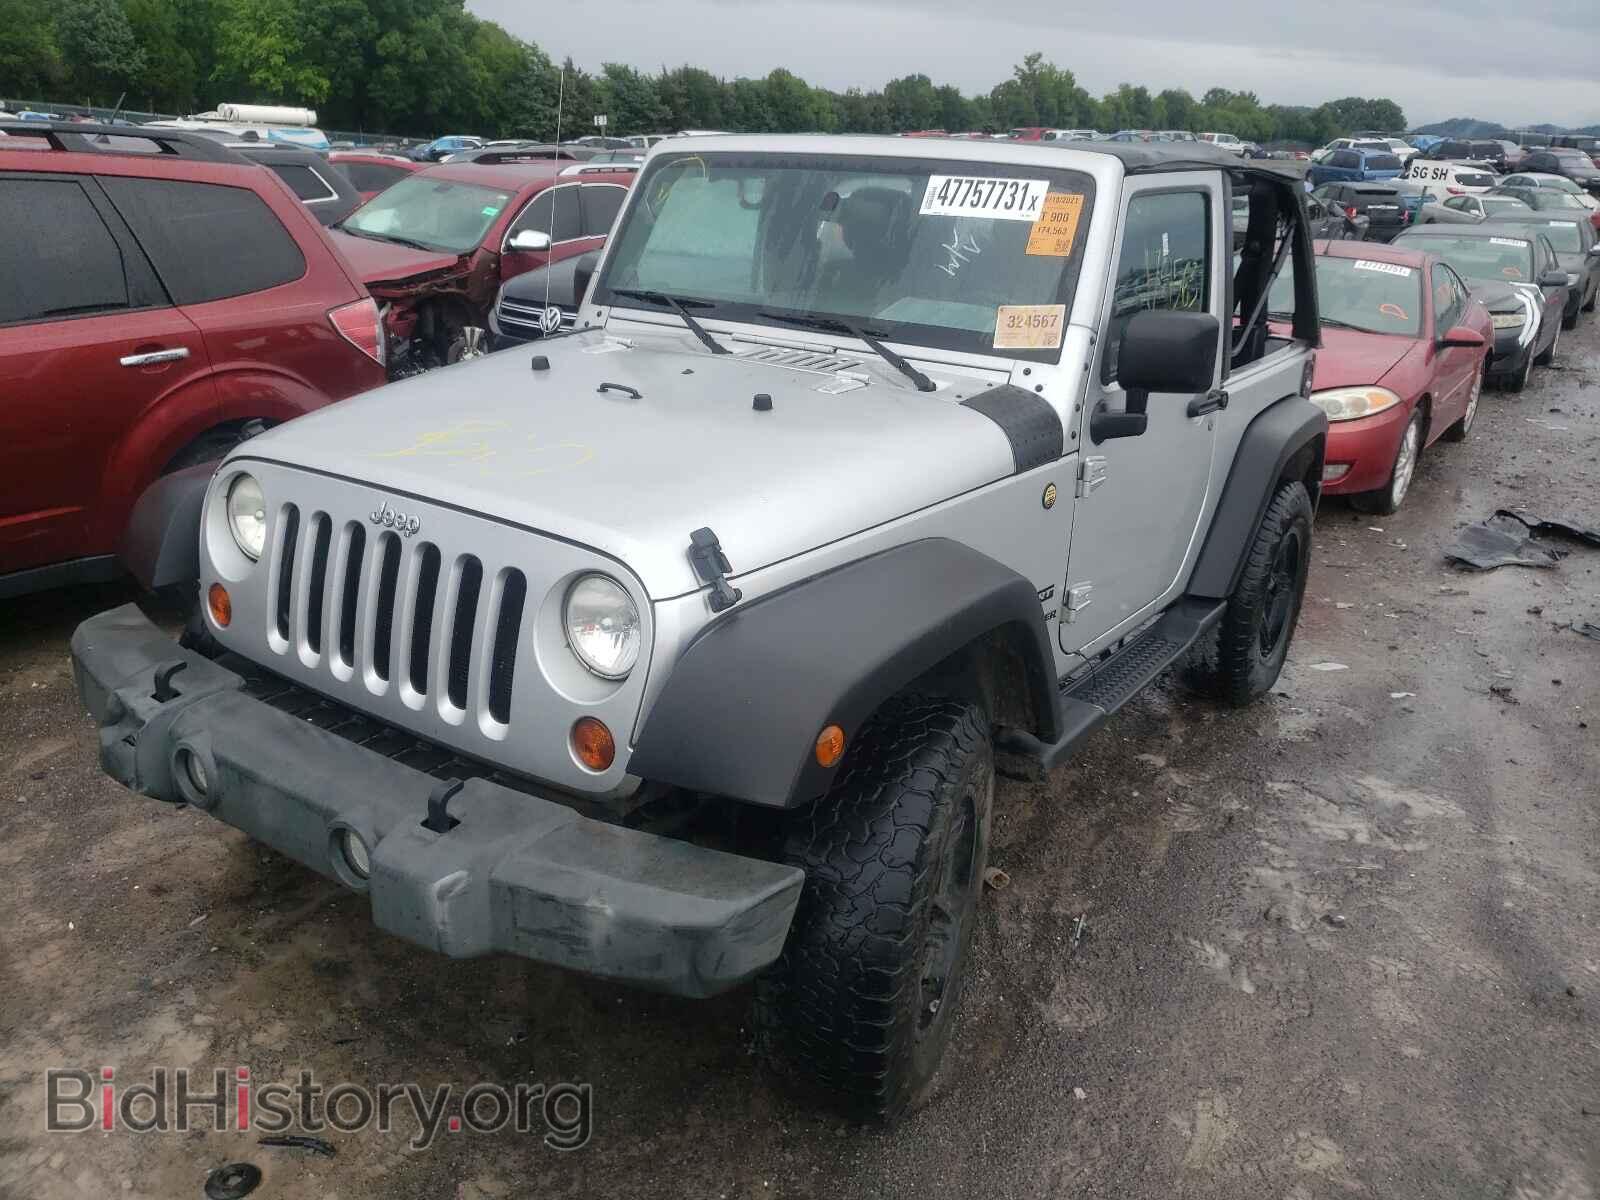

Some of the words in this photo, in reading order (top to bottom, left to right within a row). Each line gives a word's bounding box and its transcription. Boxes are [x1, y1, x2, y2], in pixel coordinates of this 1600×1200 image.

[1411, 166, 1428, 179] SG
[1431, 167, 1448, 180] SH
[1007, 314, 1059, 329] 324567
[369, 501, 420, 537] Jeep
